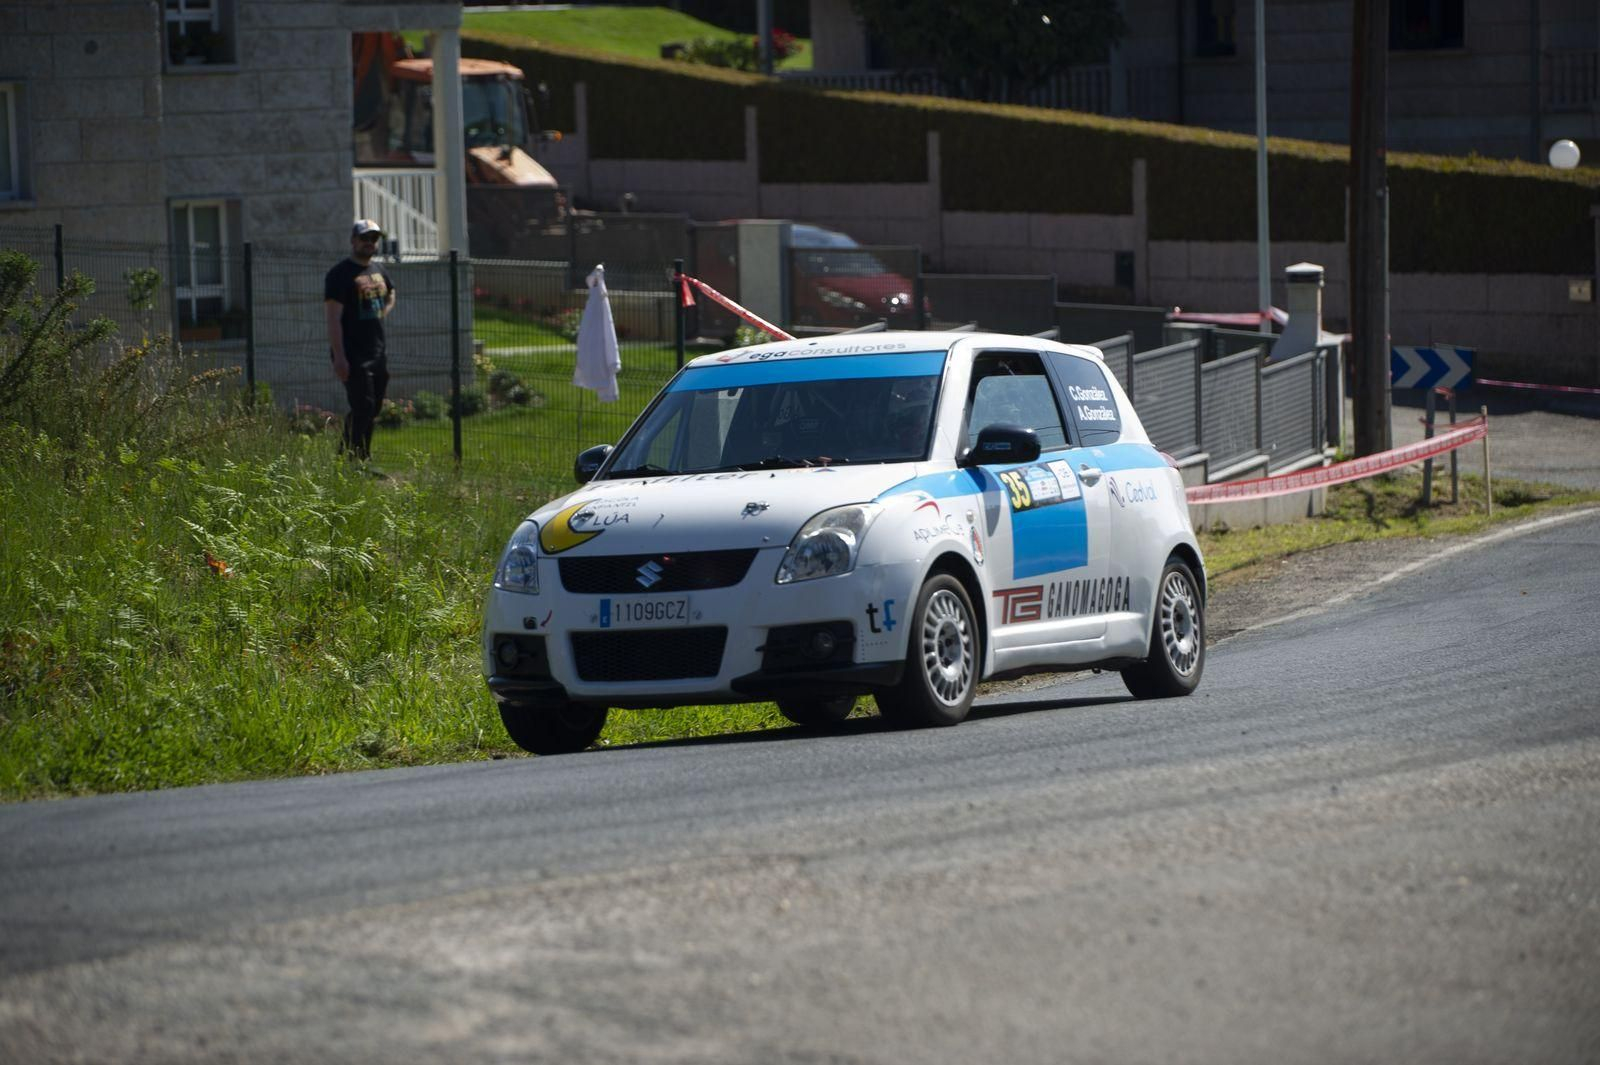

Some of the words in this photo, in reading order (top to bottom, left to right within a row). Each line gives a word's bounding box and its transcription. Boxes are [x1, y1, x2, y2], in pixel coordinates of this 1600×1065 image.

[1000, 471, 1031, 509] 35
[616, 600, 686, 621] 1109GCZ
[1047, 576, 1131, 619] GANOMAGOGA
